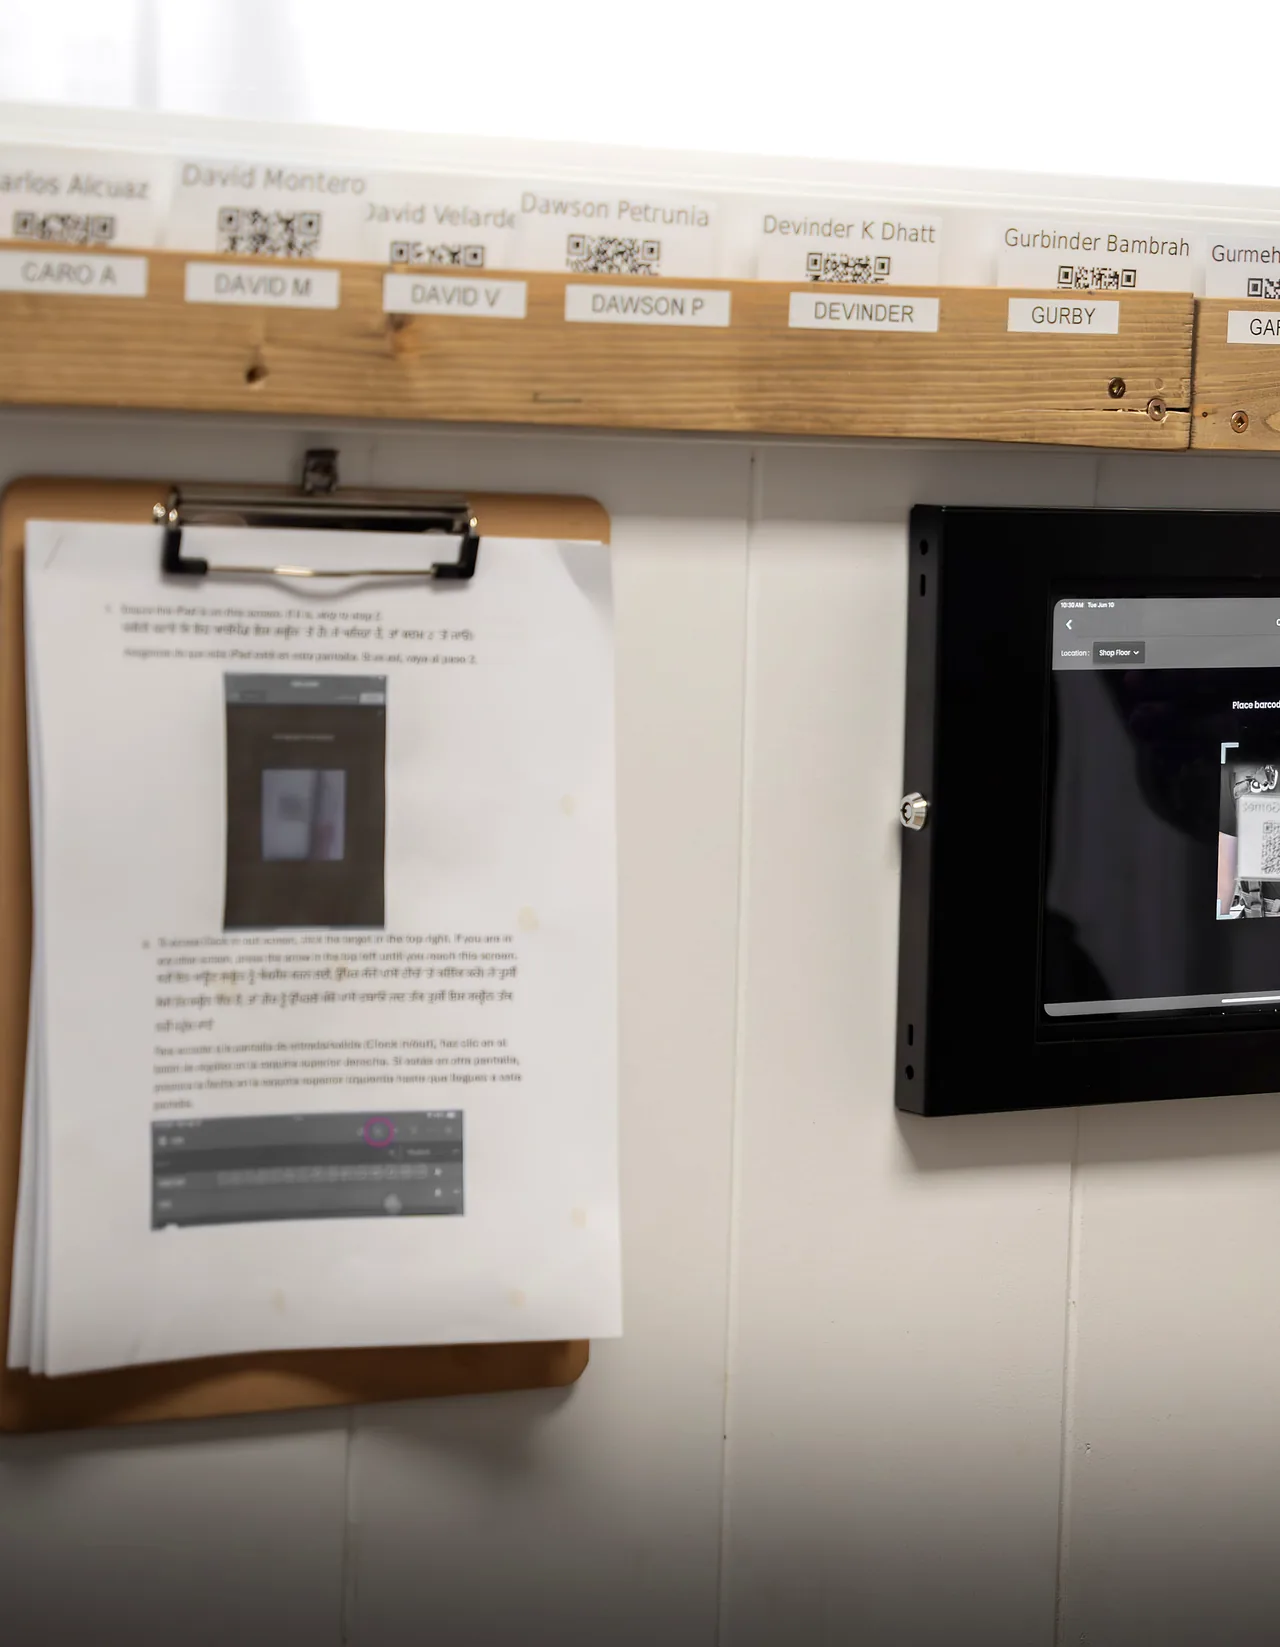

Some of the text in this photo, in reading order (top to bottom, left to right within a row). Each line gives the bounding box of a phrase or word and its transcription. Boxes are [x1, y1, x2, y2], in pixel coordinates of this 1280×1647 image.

[0, 171, 149, 199] arlos Alcuaz
[181, 163, 366, 195] David Montero
[520, 190, 710, 227] Dawson Petrunia
[763, 214, 936, 244] Devinder K Dhatt
[1004, 227, 1190, 257] Gurbinder Bambrah
[20, 260, 117, 286] CARO A
[213, 271, 313, 297] DAVID M
[410, 283, 502, 308] DAVID V
[591, 293, 705, 316] DAWSON P
[814, 301, 914, 323] DEVINDER
[1031, 305, 1096, 325] GURBY
[1099, 649, 1115, 658] Shop
[1232, 700, 1254, 709] Place
